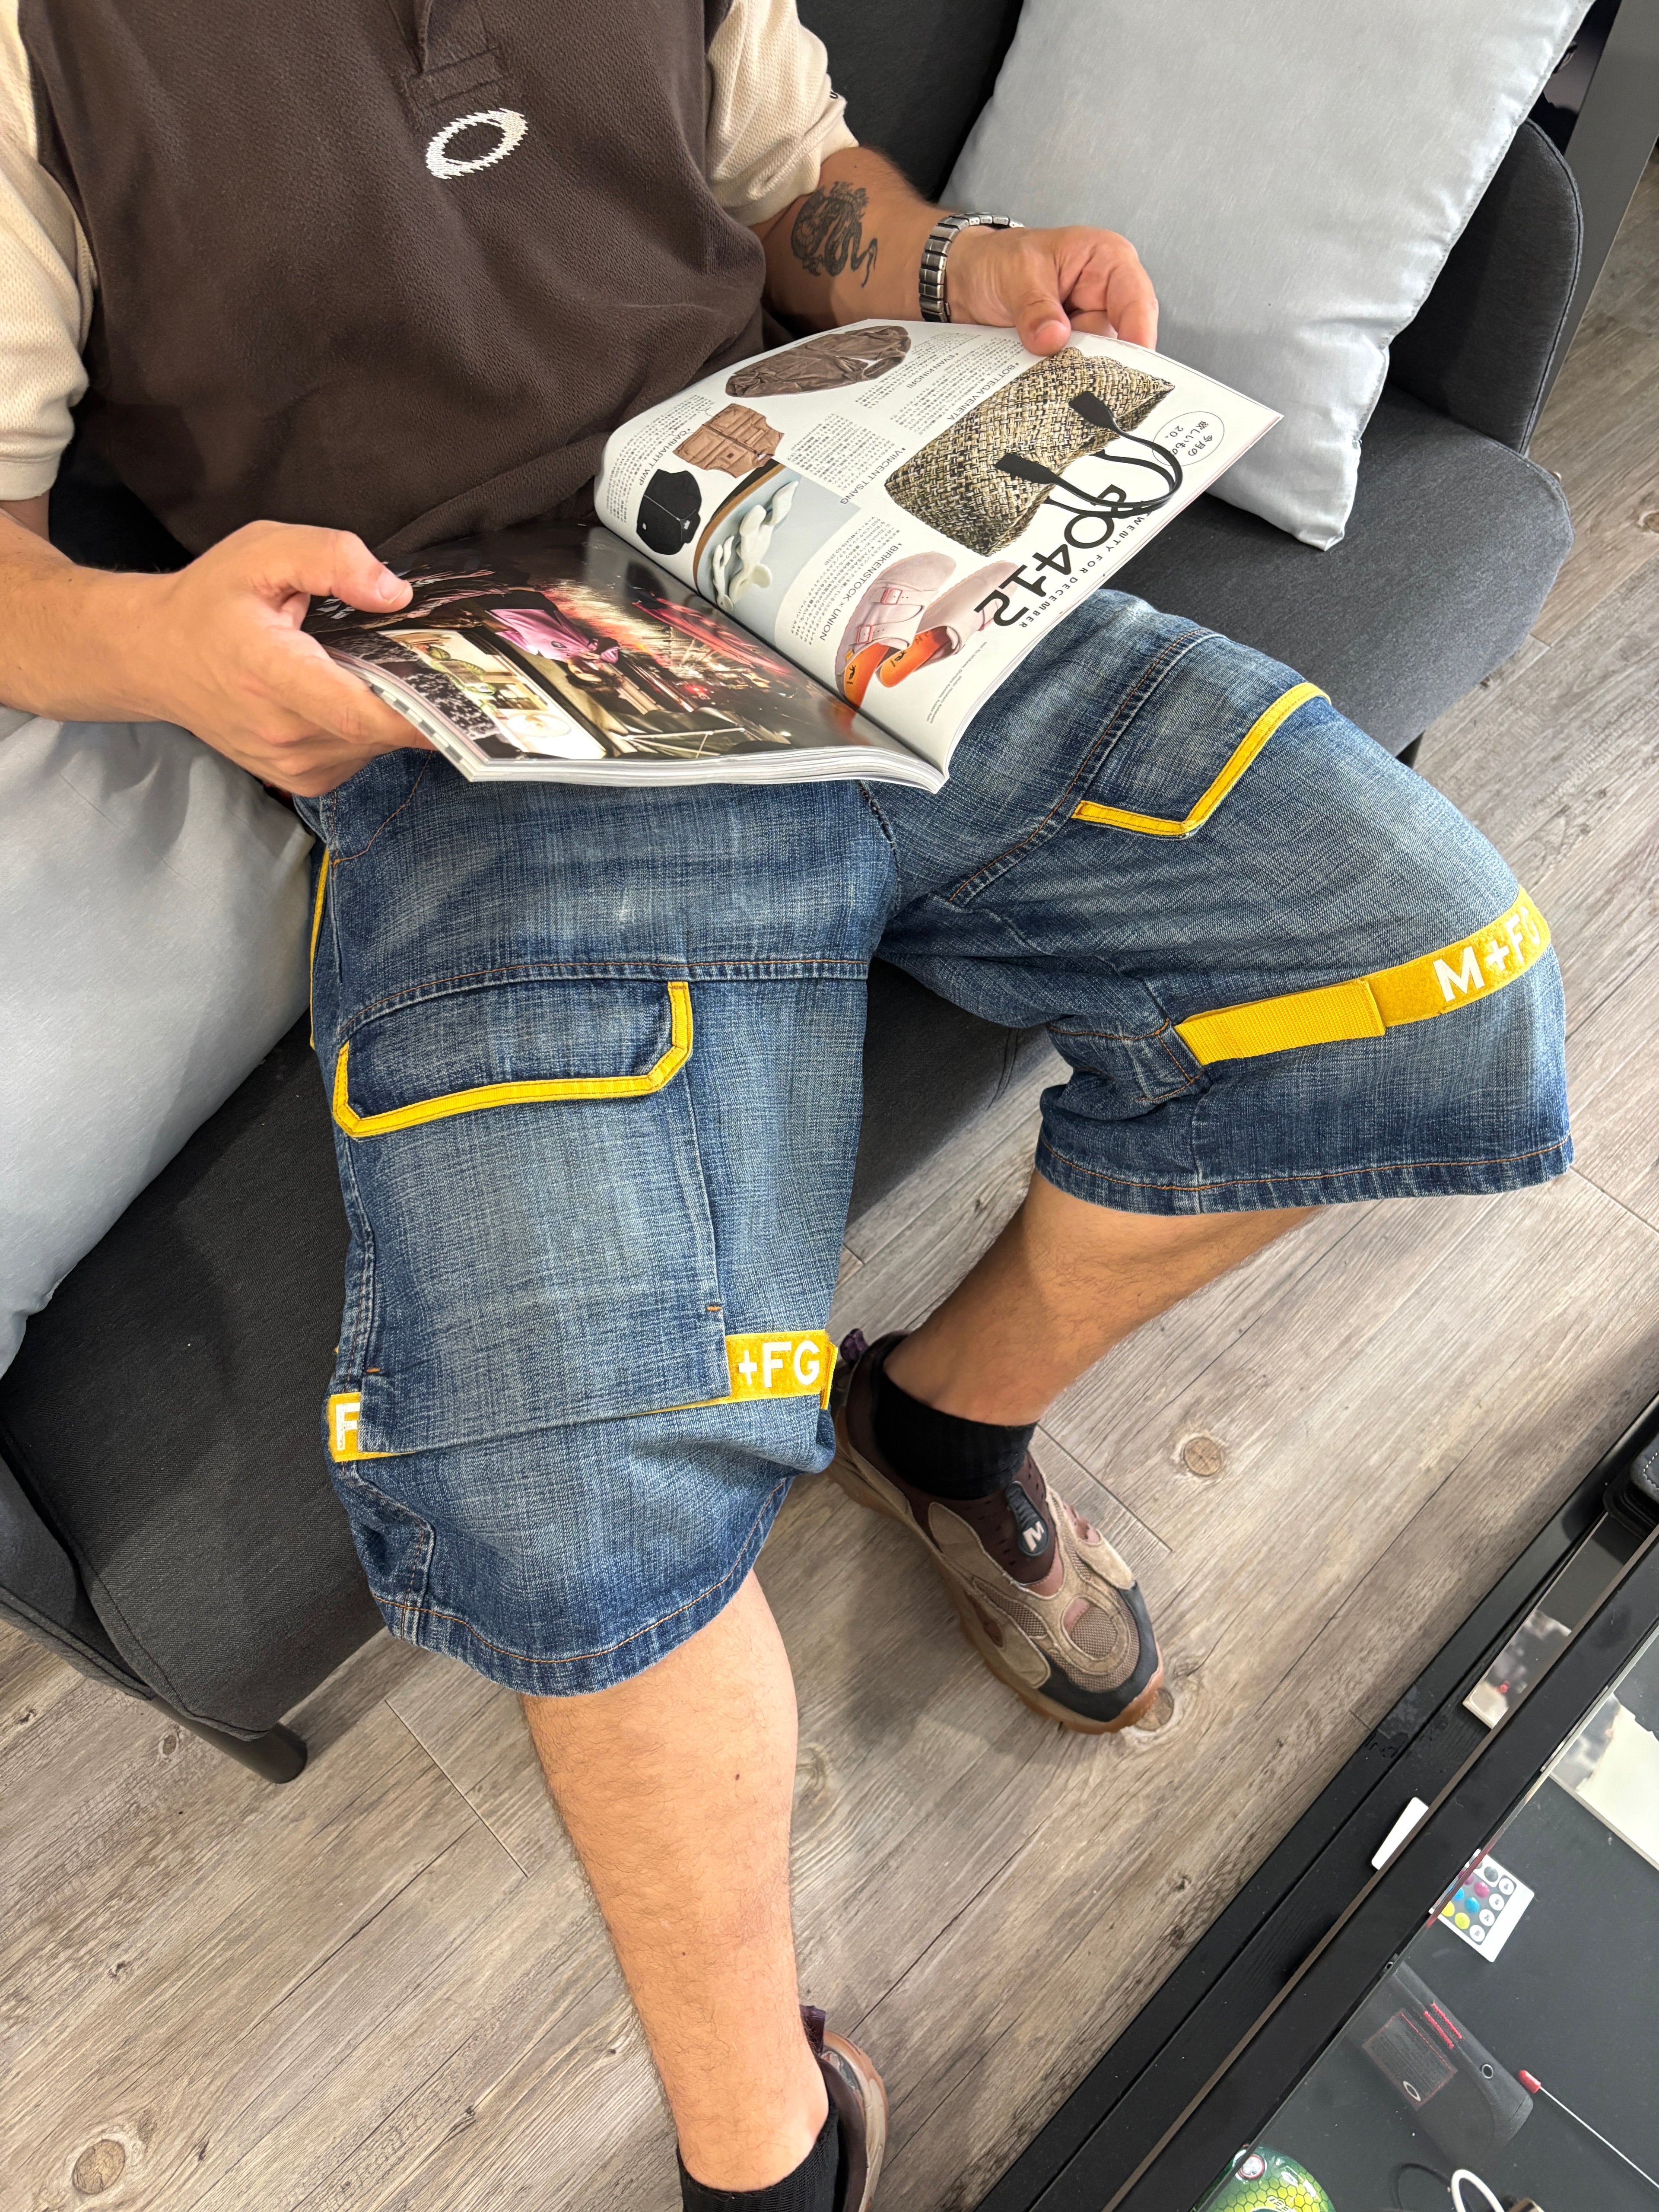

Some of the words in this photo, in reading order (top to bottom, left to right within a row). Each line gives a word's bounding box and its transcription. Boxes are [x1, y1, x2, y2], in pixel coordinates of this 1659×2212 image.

[931, 354, 955, 372] EVAN
[906, 369, 934, 388] KINORI
[976, 364, 1016, 394] BOTTEGA
[947, 395, 980, 420] VENETA
[1172, 421, 1209, 456] 欲しいもの
[1188, 435, 1213, 456] 今月の
[639, 468, 651, 486] WIP
[868, 449, 903, 481] VINCENT
[840, 480, 870, 504] TSANG
[843, 545, 899, 601] BIRKENSTOCK
[1079, 554, 1103, 573] FOR
[1019, 577, 1078, 628] DECEMBER
[820, 608, 842, 641] UNION
[336, 1402, 361, 1451] F
